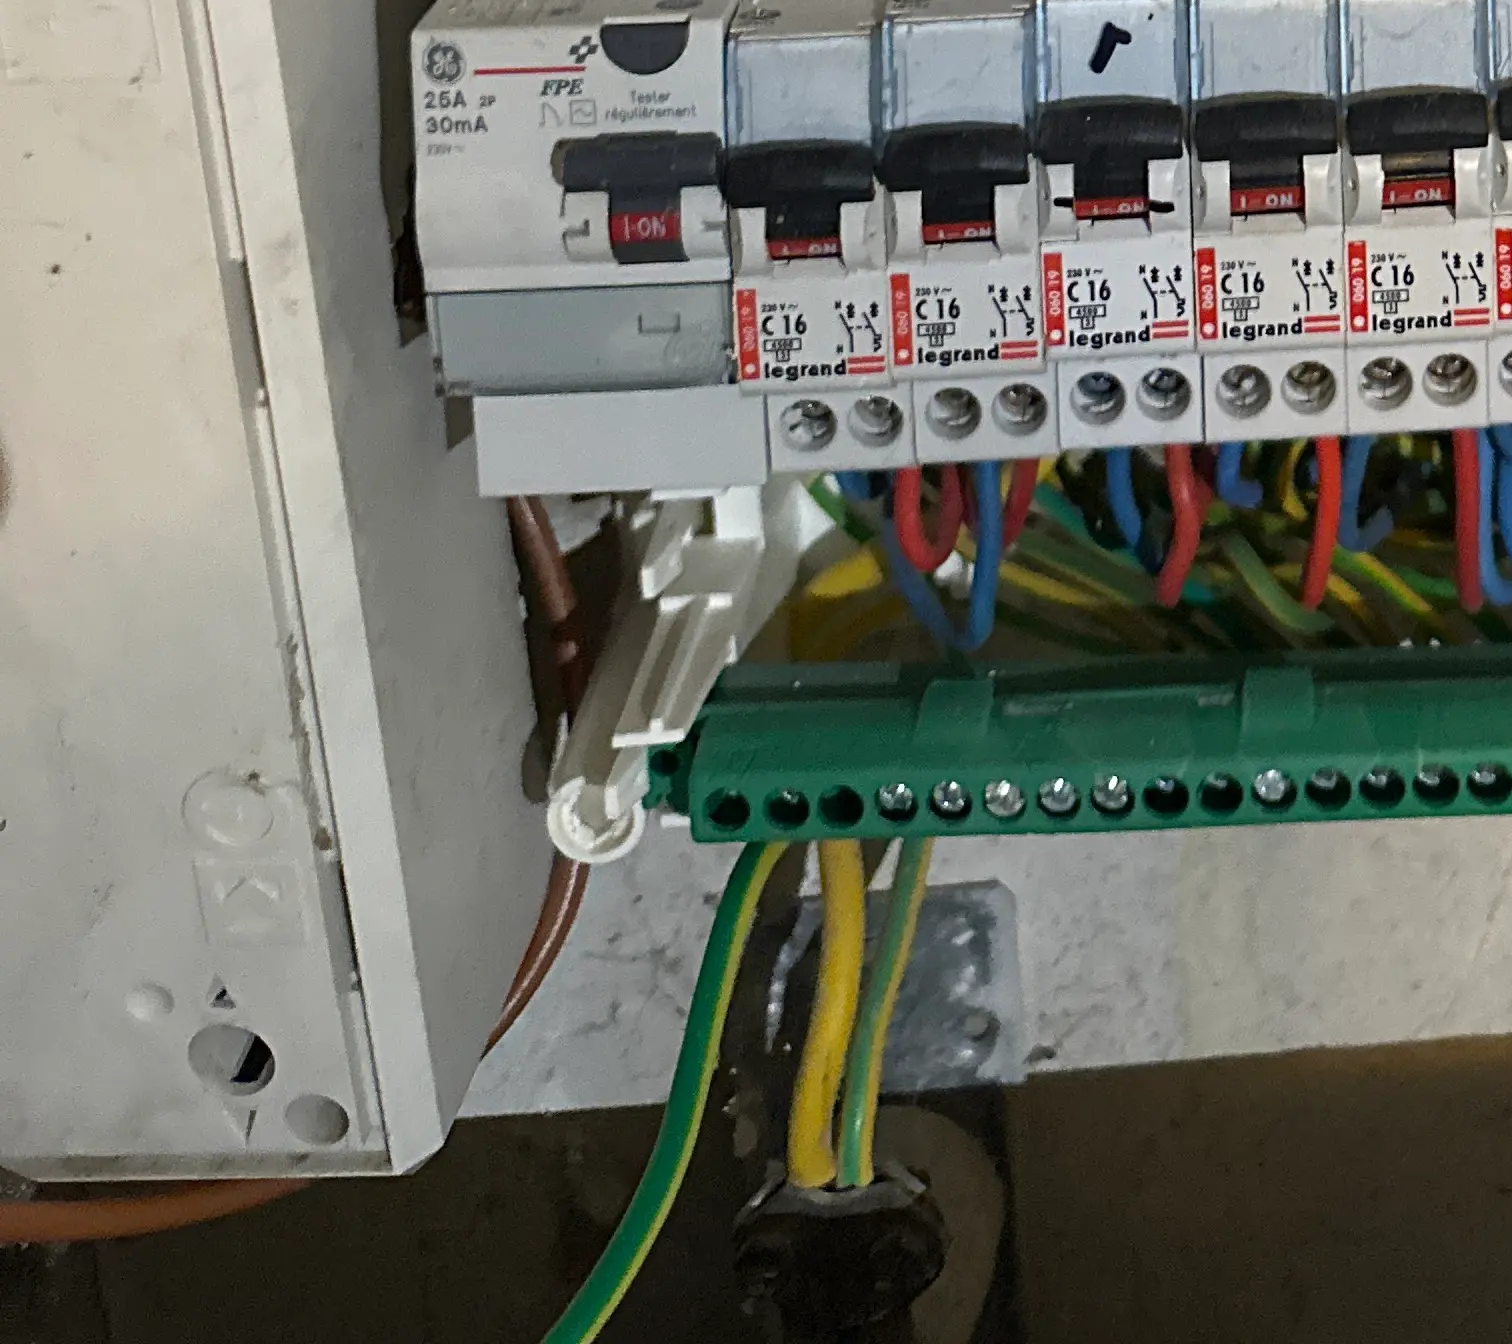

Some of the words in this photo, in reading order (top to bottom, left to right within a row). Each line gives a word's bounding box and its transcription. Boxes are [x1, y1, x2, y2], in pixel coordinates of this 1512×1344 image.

[630, 90, 671, 102] Tester
[425, 116, 488, 134] 30mA
[1240, 272, 1265, 294] 16
[1390, 264, 1415, 287] 16
[1086, 280, 1112, 302] 16
[934, 298, 961, 320] 16
[780, 315, 807, 336] 16
[1221, 319, 1303, 341] legrand
[1371, 310, 1452, 335] legrand
[1069, 326, 1151, 349] legrand
[917, 343, 999, 366] legrand
[763, 360, 847, 382] legrand
